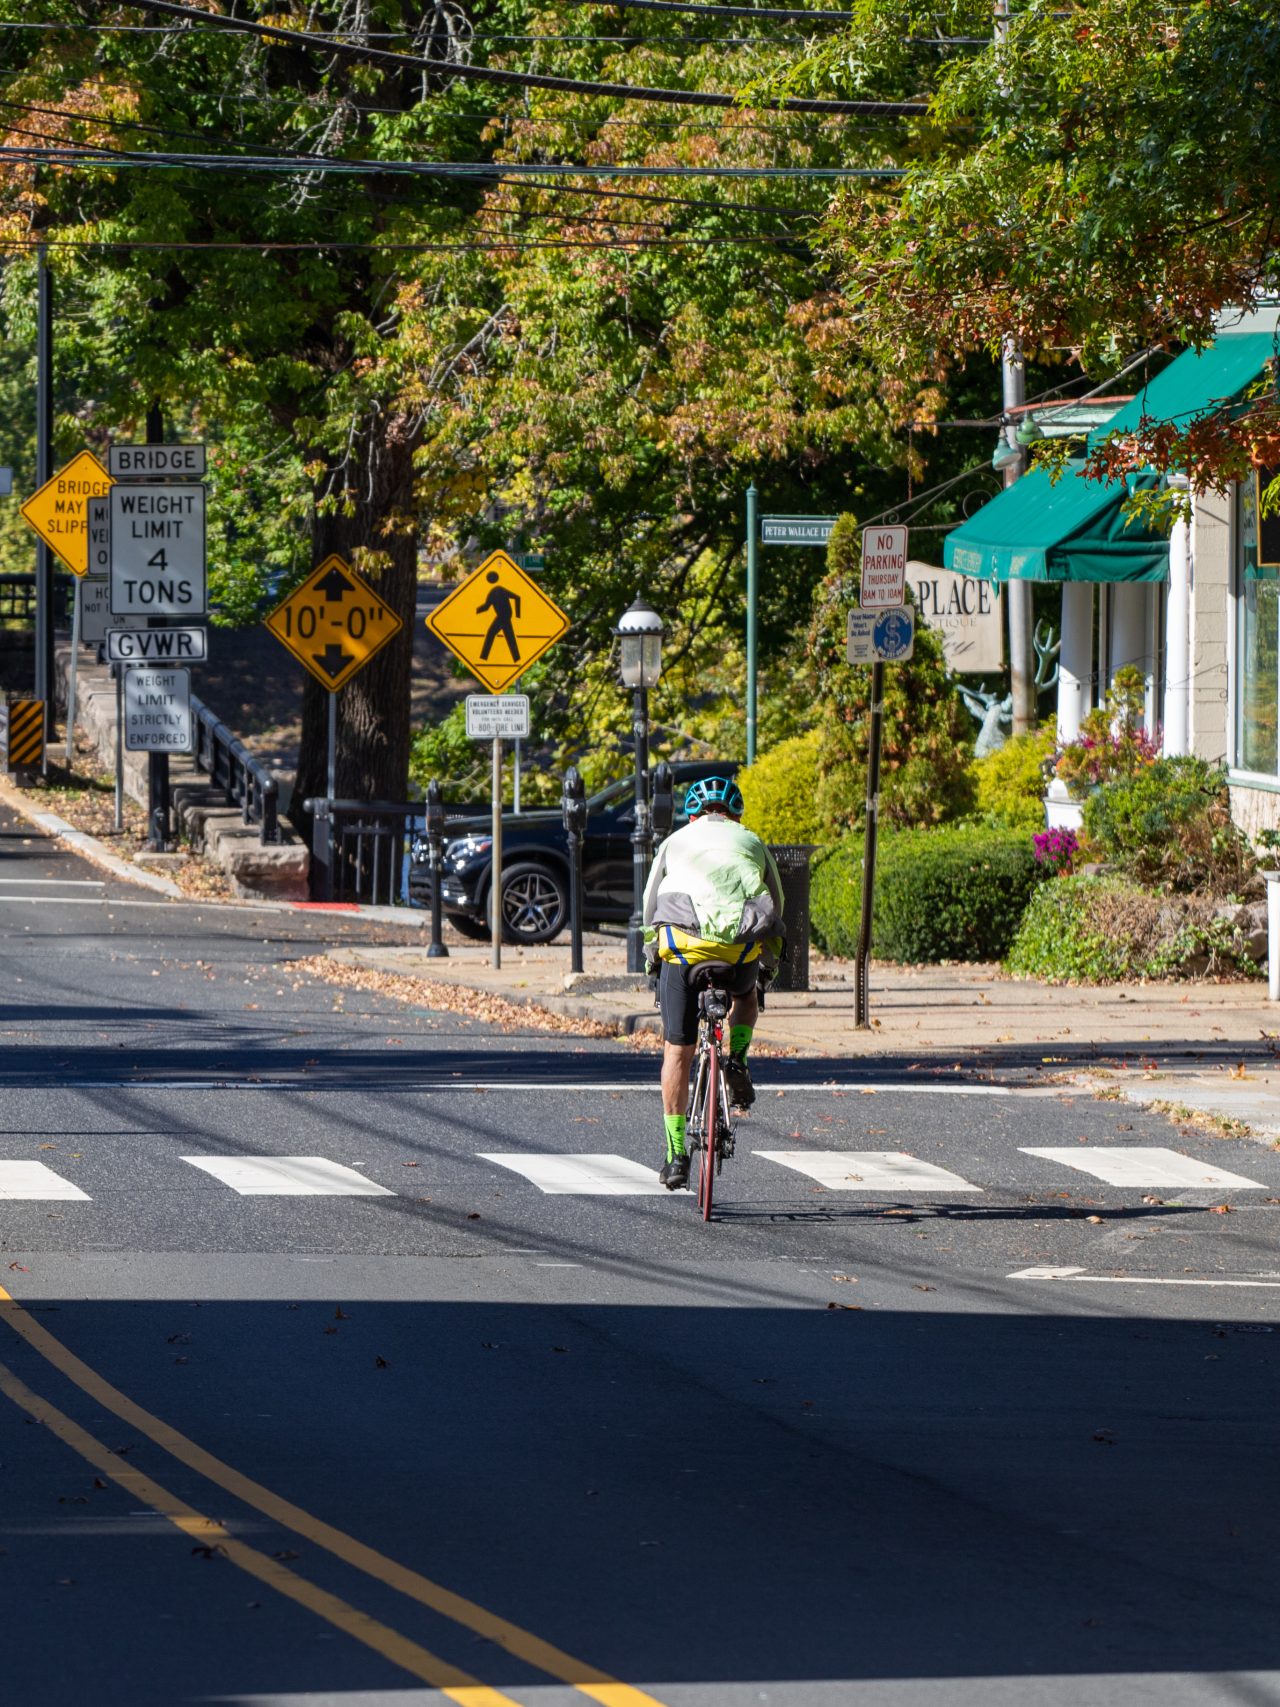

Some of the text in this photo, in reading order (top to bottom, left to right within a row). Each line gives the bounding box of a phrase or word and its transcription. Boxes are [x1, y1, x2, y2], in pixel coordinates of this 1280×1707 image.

[119, 450, 196, 470] BRIDGE
[57, 480, 109, 496] BRIDGE
[55, 500, 83, 514] MAY
[121, 496, 196, 514] WEIGHT
[47, 519, 88, 534] SLIPP
[132, 520, 183, 539] LIMIT
[765, 526, 787, 536] PETER
[788, 526, 819, 537] WALLACE
[877, 535, 893, 550] NO
[147, 548, 168, 571] 4
[865, 554, 903, 570] PARKING
[868, 574, 899, 585] THURSDAY
[123, 580, 193, 604] TONS
[863, 588, 902, 600] 8AM TO 10AM
[917, 578, 991, 615] PLACE
[84, 602, 101, 612] NOT
[928, 618, 977, 627] NTIQUE
[118, 633, 193, 657] GVWR
[136, 676, 176, 687] WEIGHT
[138, 694, 176, 706] LIMIT
[131, 714, 182, 725] STRICTLY
[130, 733, 187, 745] ENFORCED
